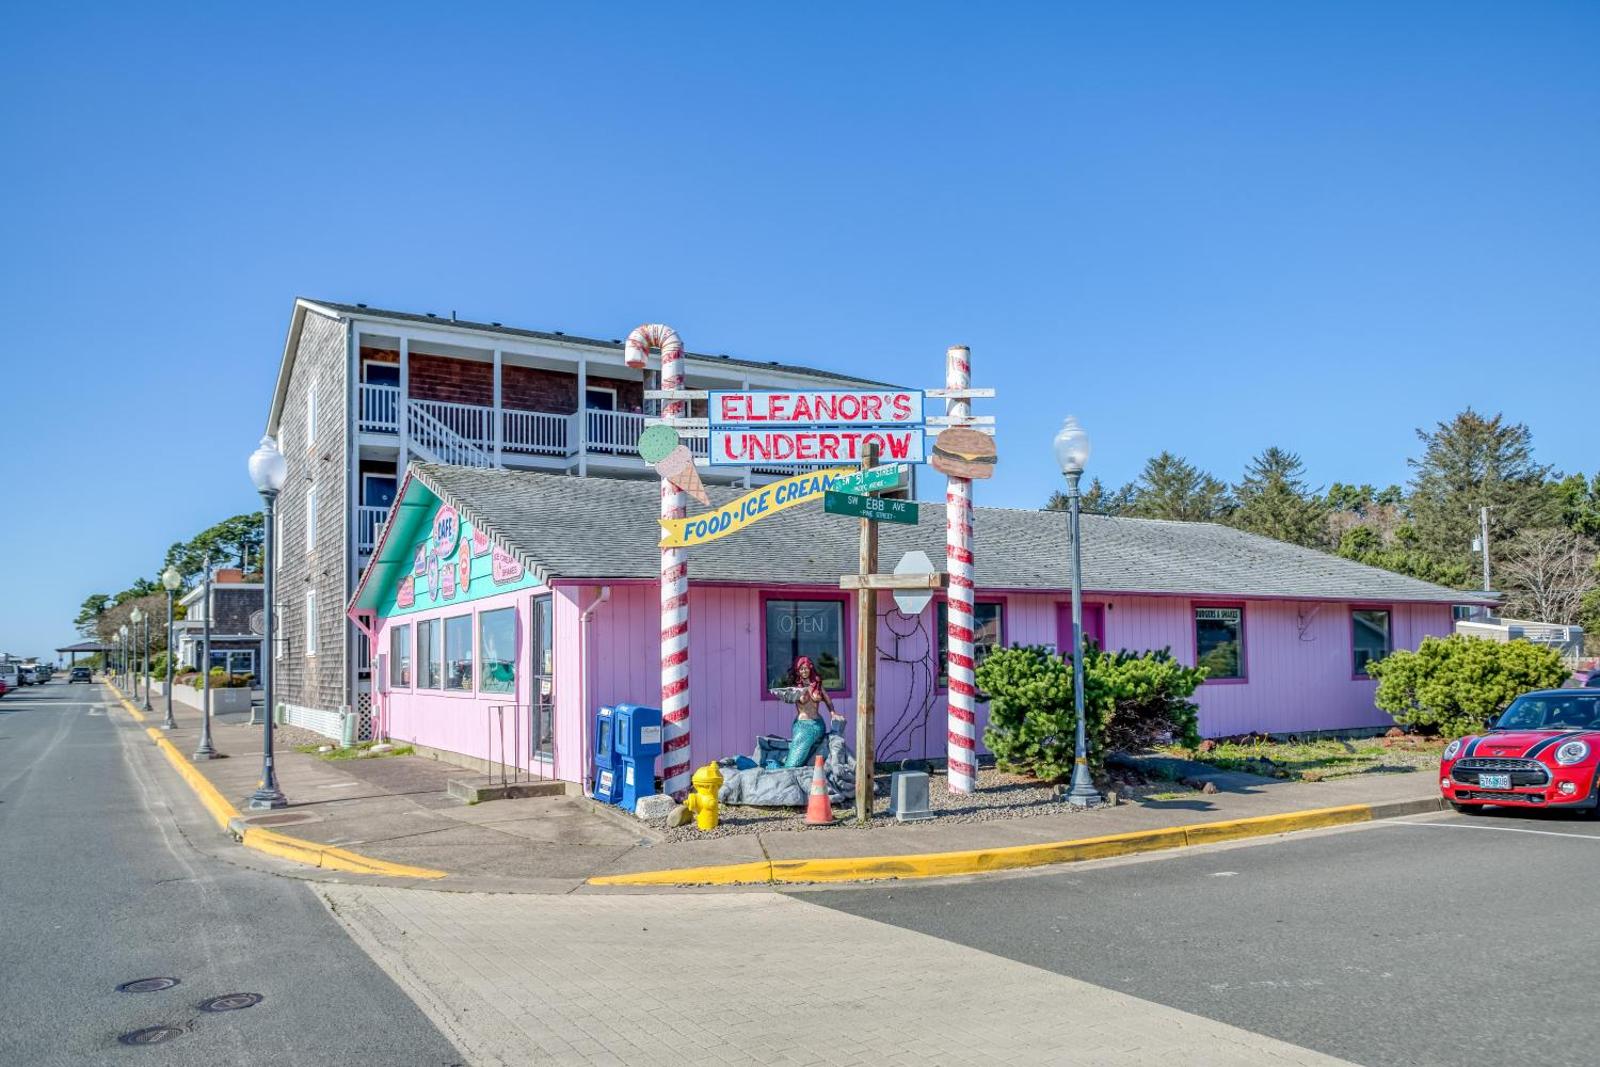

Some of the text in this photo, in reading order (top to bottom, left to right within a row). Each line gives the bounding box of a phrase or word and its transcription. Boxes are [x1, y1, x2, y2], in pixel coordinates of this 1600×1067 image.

[721, 394, 912, 421] ELEANOR'S
[724, 432, 912, 460] UNDERTOW
[876, 466, 897, 478] STREET
[774, 473, 841, 505] CREAM
[847, 495, 906, 512] SW EBB AVE
[781, 615, 824, 633] OPEN
